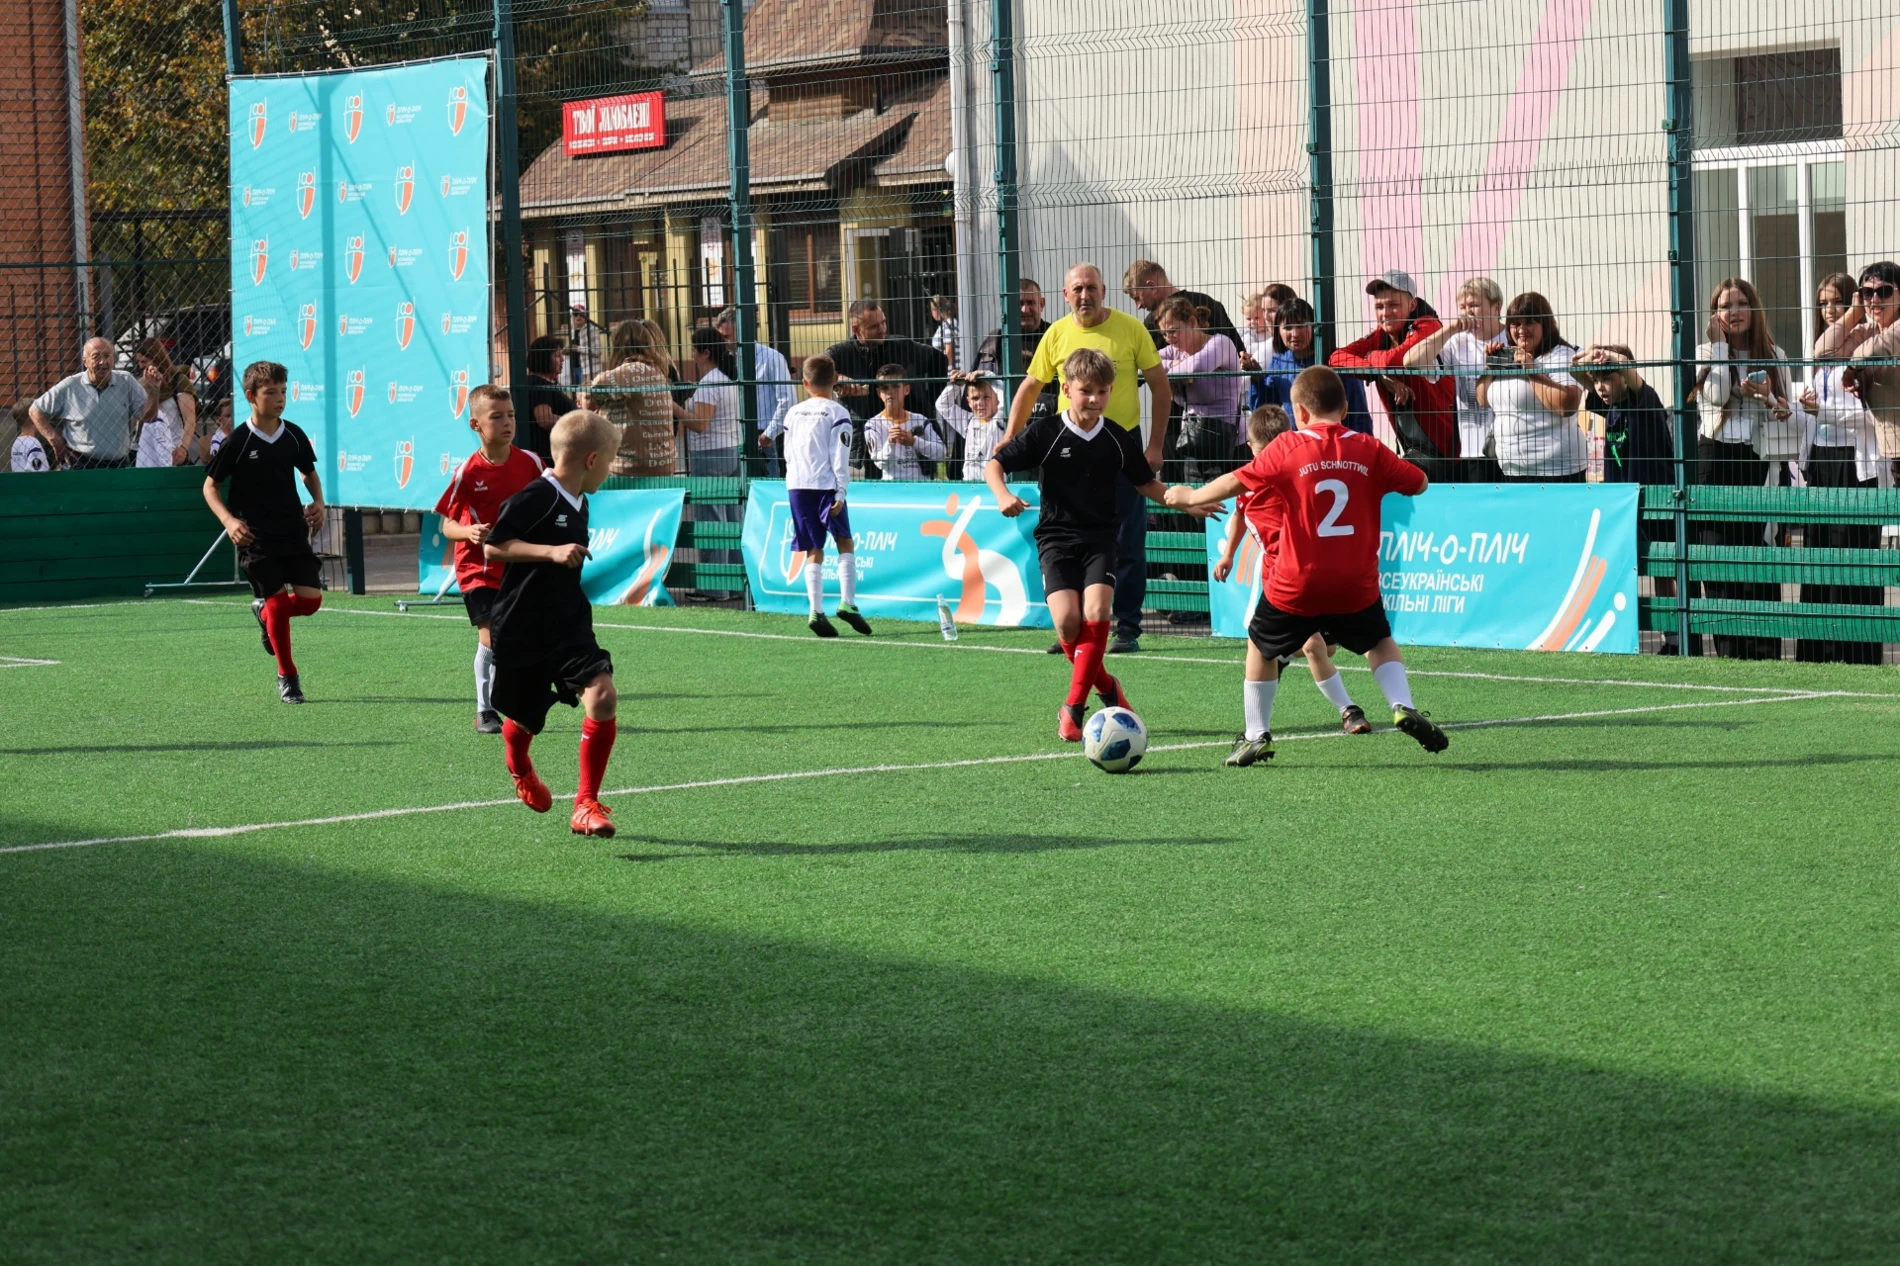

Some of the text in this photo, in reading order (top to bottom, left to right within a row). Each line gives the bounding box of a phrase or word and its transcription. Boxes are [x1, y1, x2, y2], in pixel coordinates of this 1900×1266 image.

[1299, 462, 1319, 477] JUTU
[1314, 478, 1355, 537] 2
[1378, 531, 1529, 565] ПЛІЧ-О-ПЛІЧ
[1382, 594, 1466, 613] КІЛЬНІ ЛІГИ
